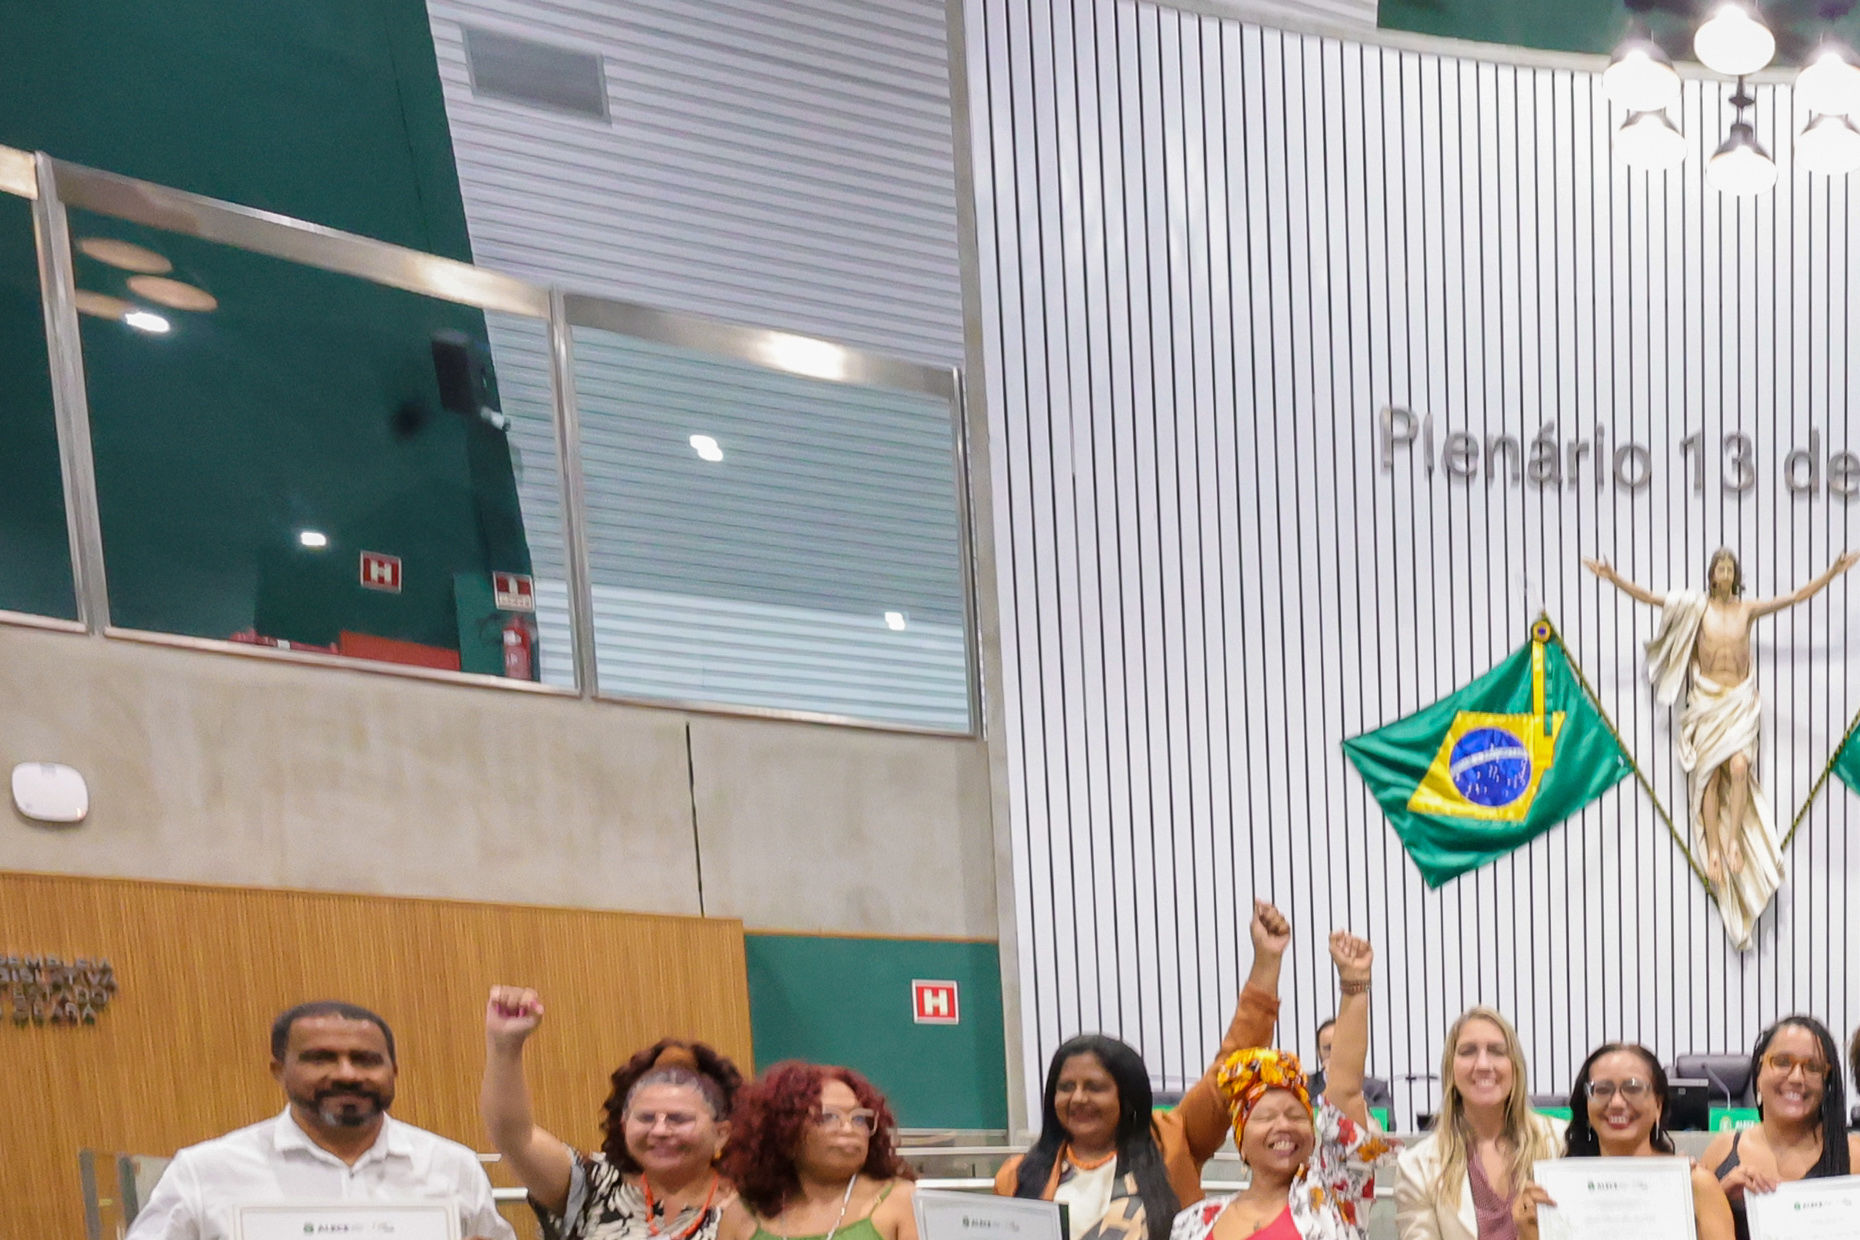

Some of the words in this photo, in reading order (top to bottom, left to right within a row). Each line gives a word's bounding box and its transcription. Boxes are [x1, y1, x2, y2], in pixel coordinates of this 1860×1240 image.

[1379, 404, 1652, 492] Plenário
[1679, 430, 1755, 497] 13
[1784, 425, 1860, 498] de
[370, 559, 392, 583] H
[924, 988, 948, 1016] H
